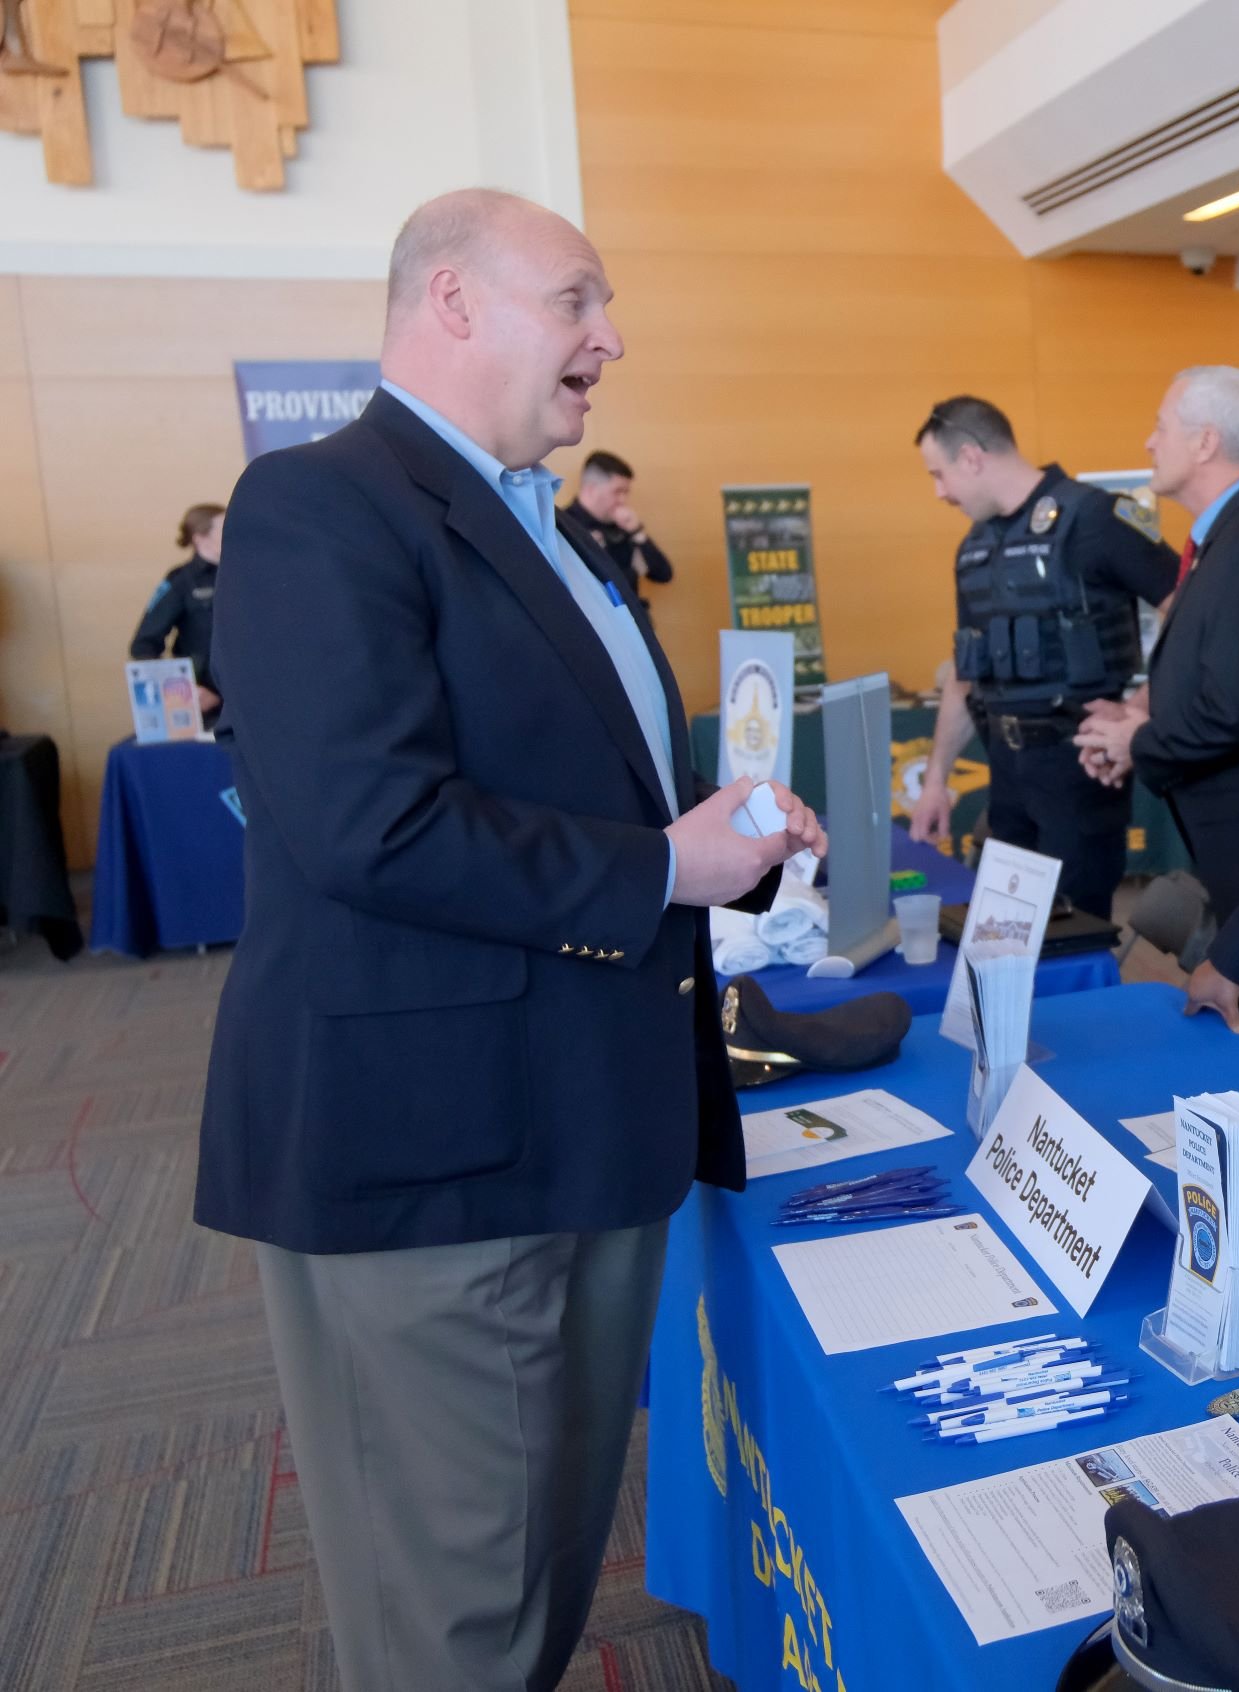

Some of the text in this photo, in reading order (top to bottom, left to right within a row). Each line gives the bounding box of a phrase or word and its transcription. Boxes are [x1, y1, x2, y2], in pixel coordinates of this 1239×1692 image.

[748, 551, 798, 572] STATE
[741, 604, 817, 626] TROOPER
[1180, 1118, 1212, 1147] NANTUCKET
[1027, 1114, 1097, 1203] Nantucket
[1188, 1138, 1207, 1156] POLICE
[1182, 1148, 1215, 1175] DEPARTMENT
[985, 1132, 1102, 1279] Police Department
[1186, 1190, 1217, 1219] POLICE
